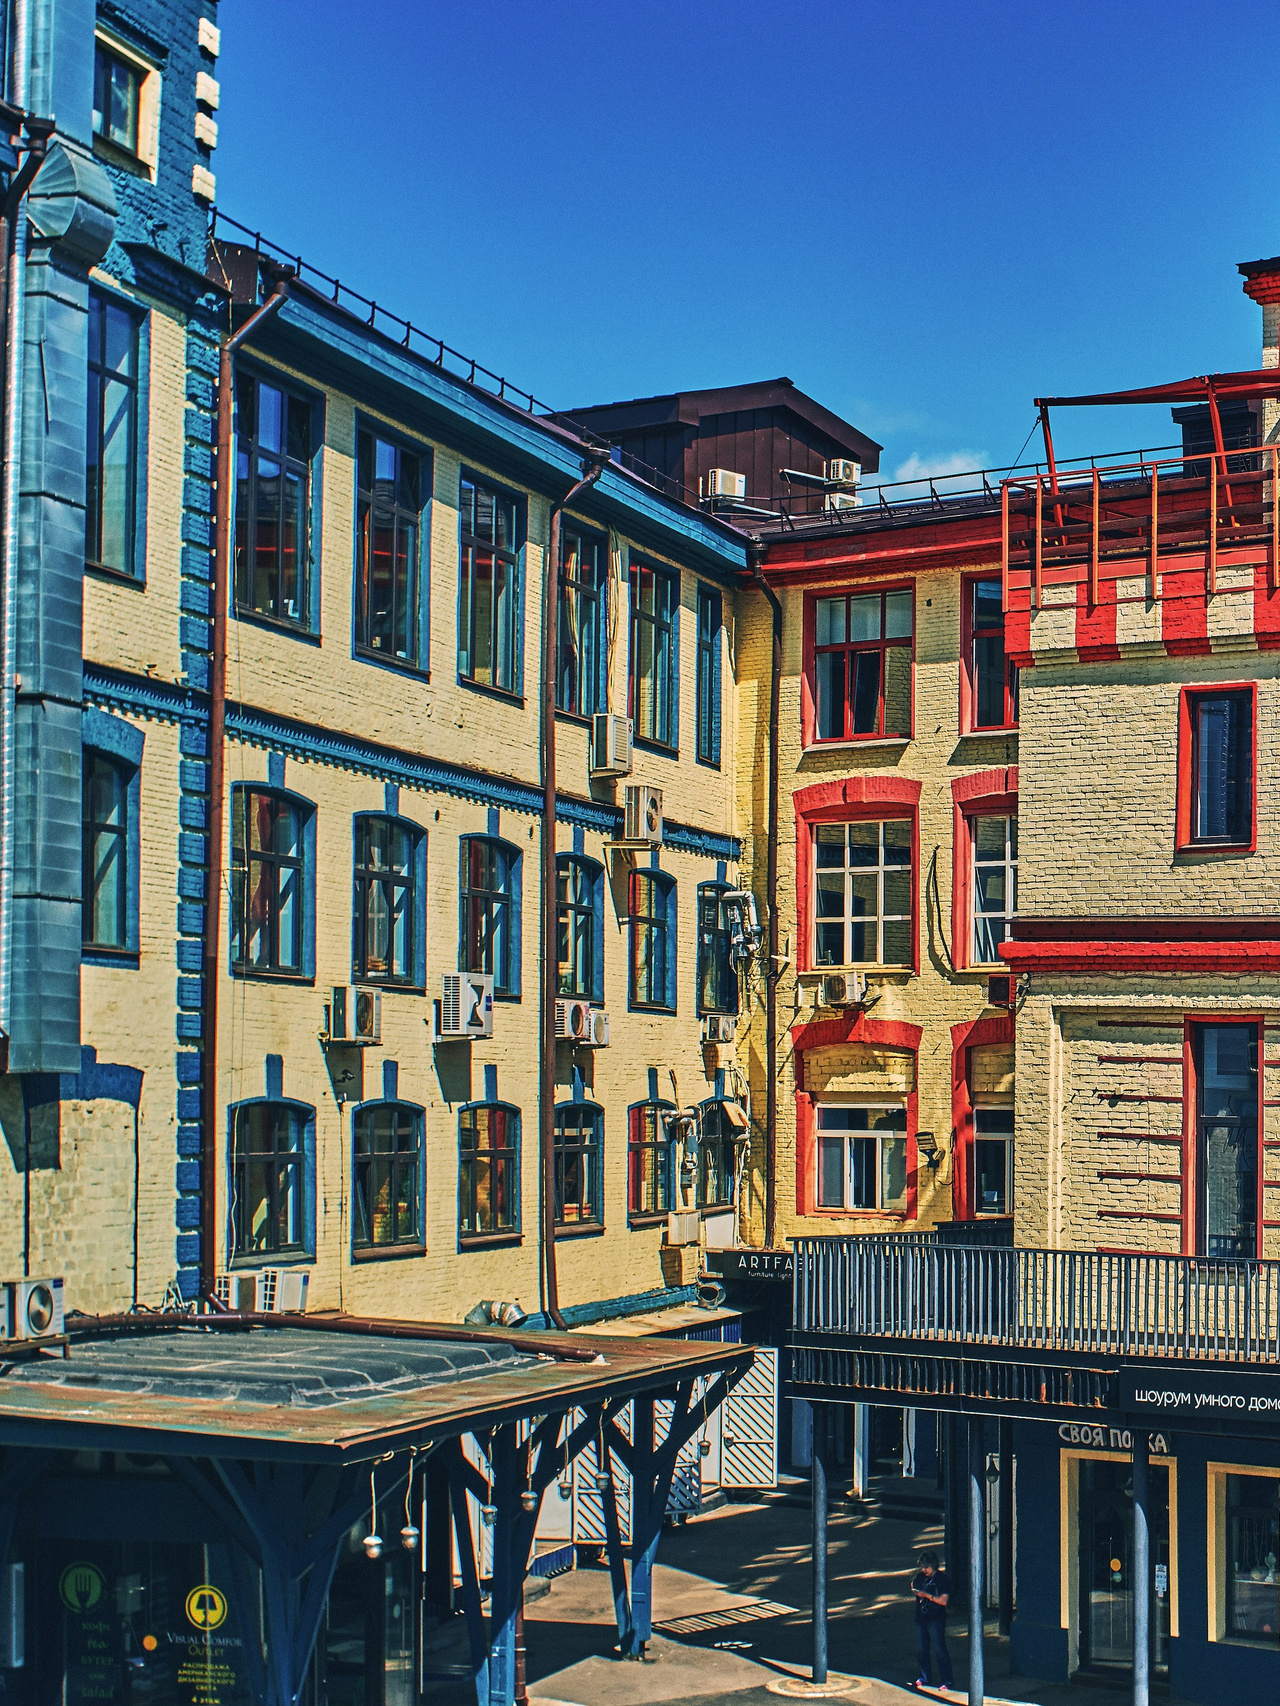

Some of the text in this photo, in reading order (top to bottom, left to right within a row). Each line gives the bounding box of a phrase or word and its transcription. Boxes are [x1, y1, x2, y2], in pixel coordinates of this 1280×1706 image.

[1135, 1389, 1191, 1408] шоурум
[1194, 1392, 1246, 1409] умного
[1058, 1423, 1104, 1447] СВОЯ
[191, 1695, 197, 1703] 4
